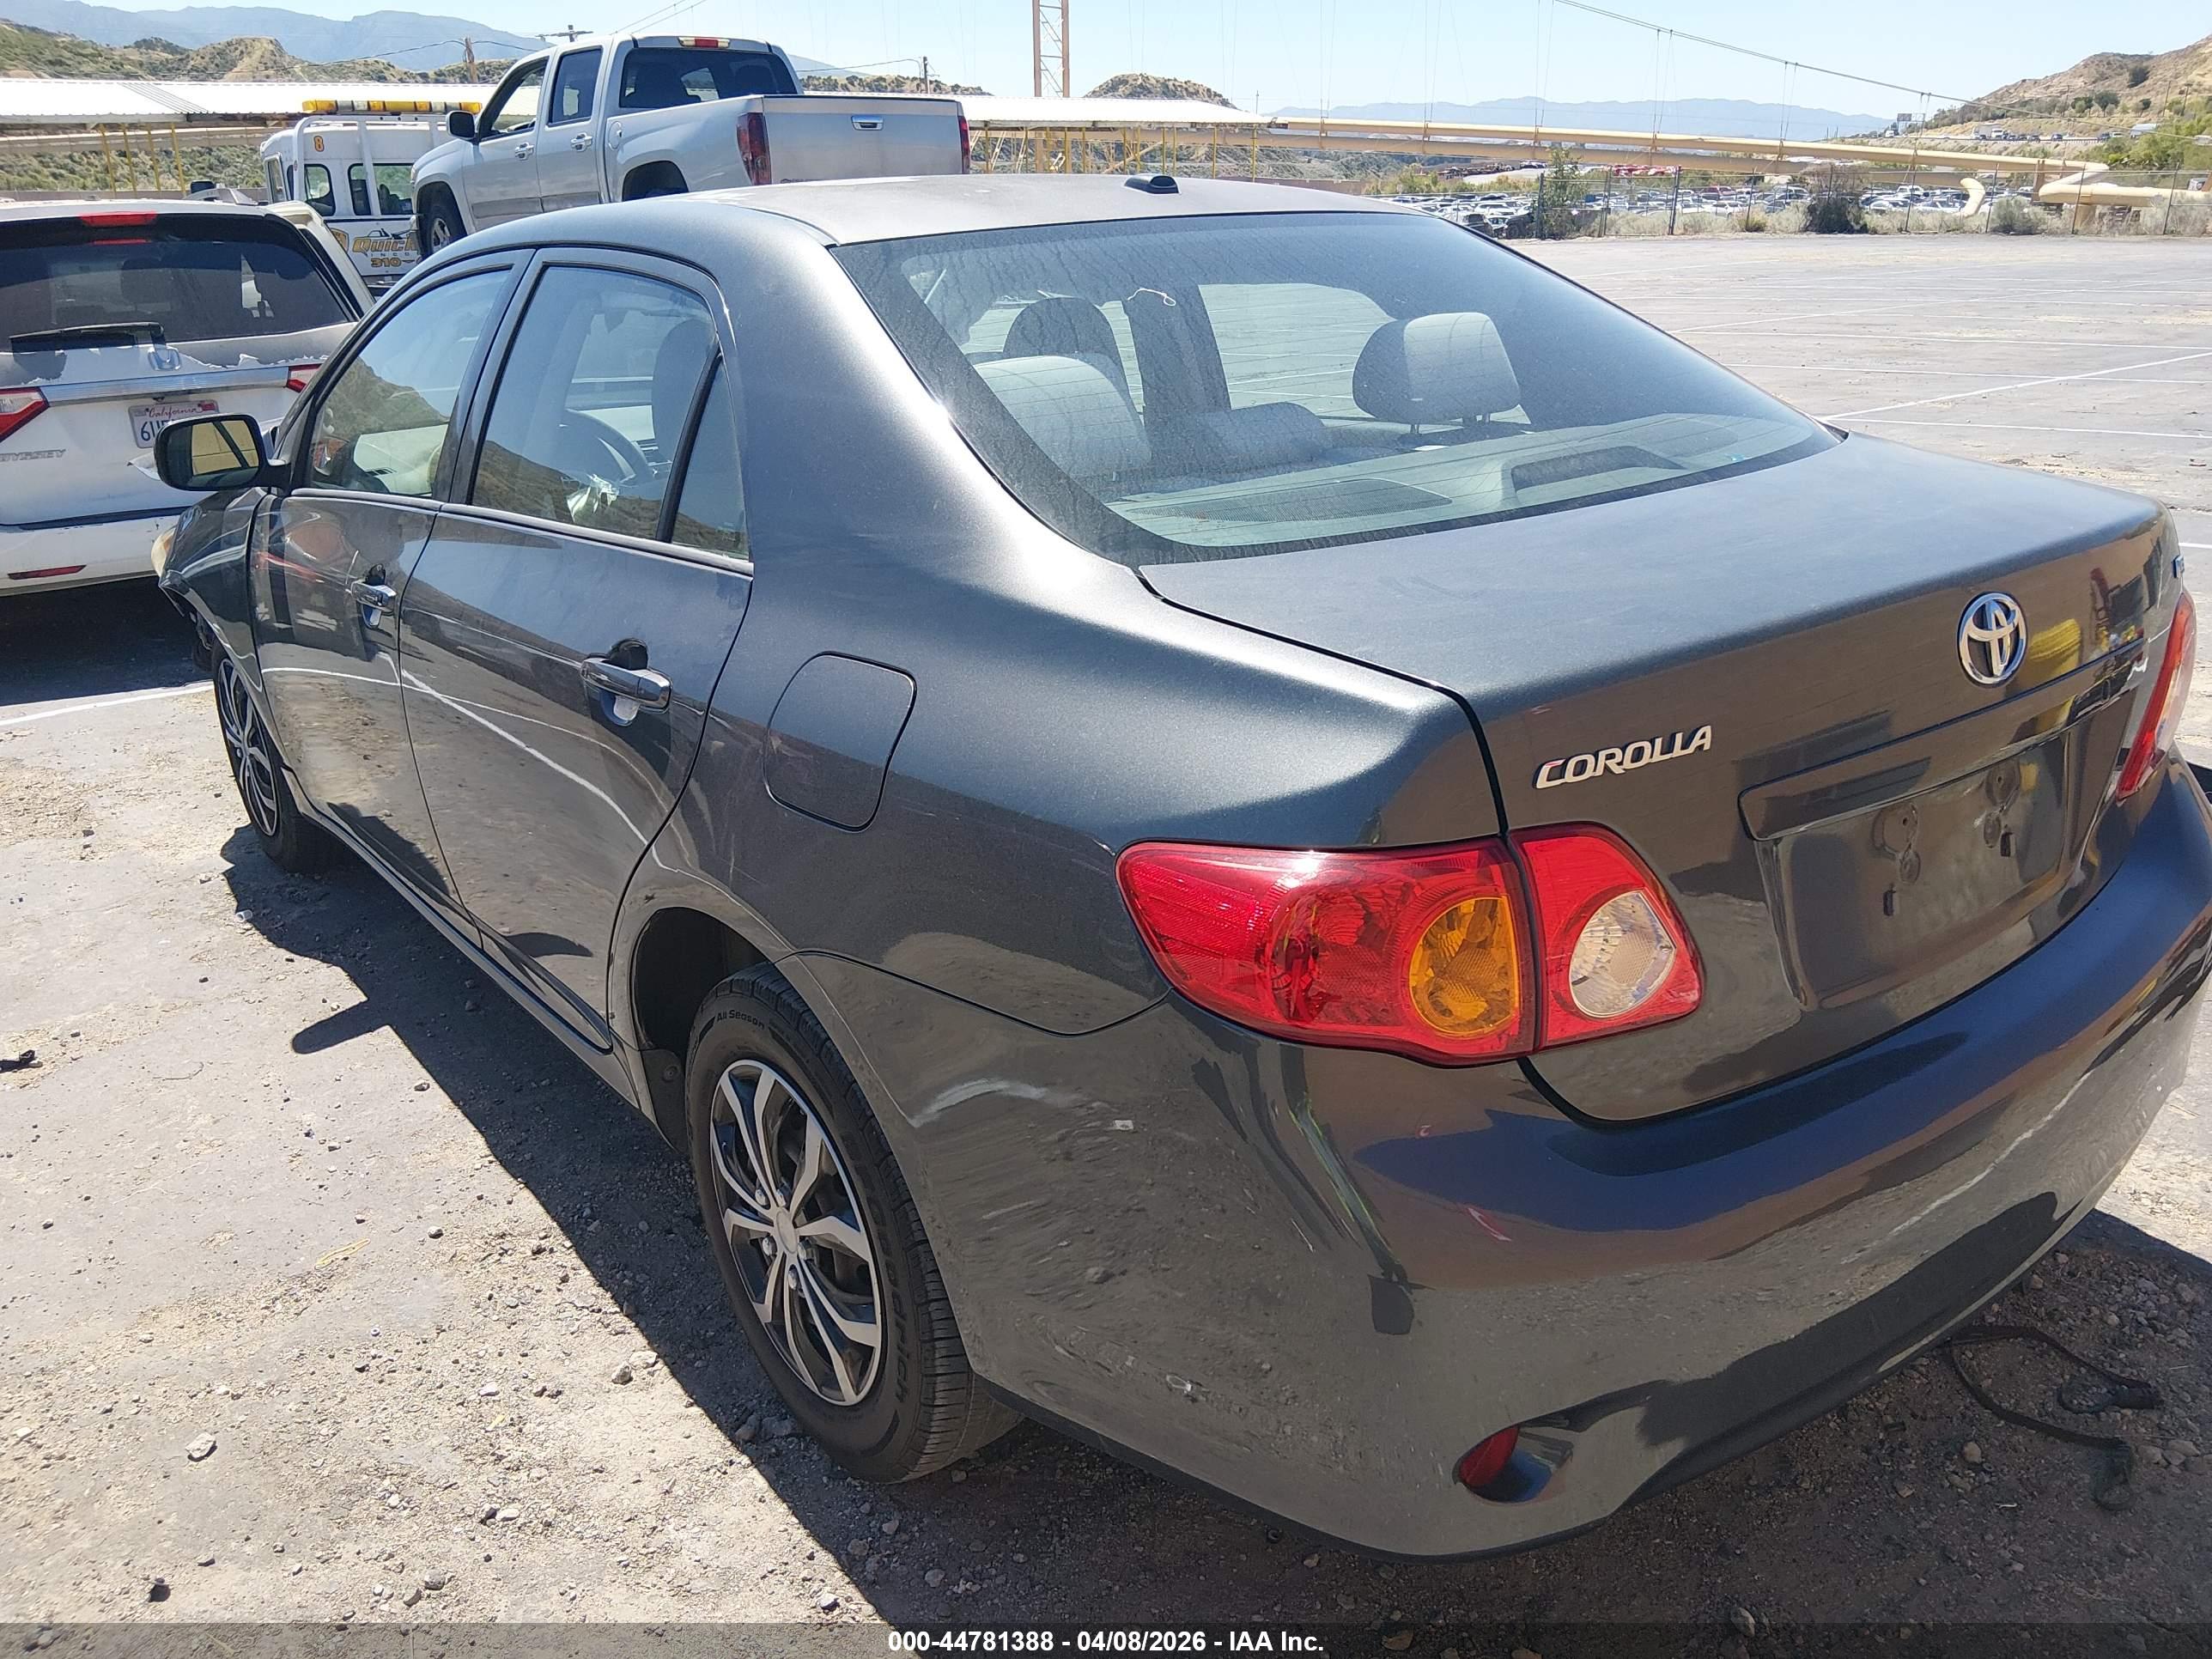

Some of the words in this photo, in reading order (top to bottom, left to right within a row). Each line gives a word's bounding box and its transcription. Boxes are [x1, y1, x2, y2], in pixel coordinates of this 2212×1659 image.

[314, 136, 324, 152] 8
[149, 406, 203, 419] California
[0, 449, 66, 462] DYSSEY
[1533, 725, 1711, 789] COROLLA
[716, 1011, 728, 1022] All
[729, 1009, 765, 1031] Season
